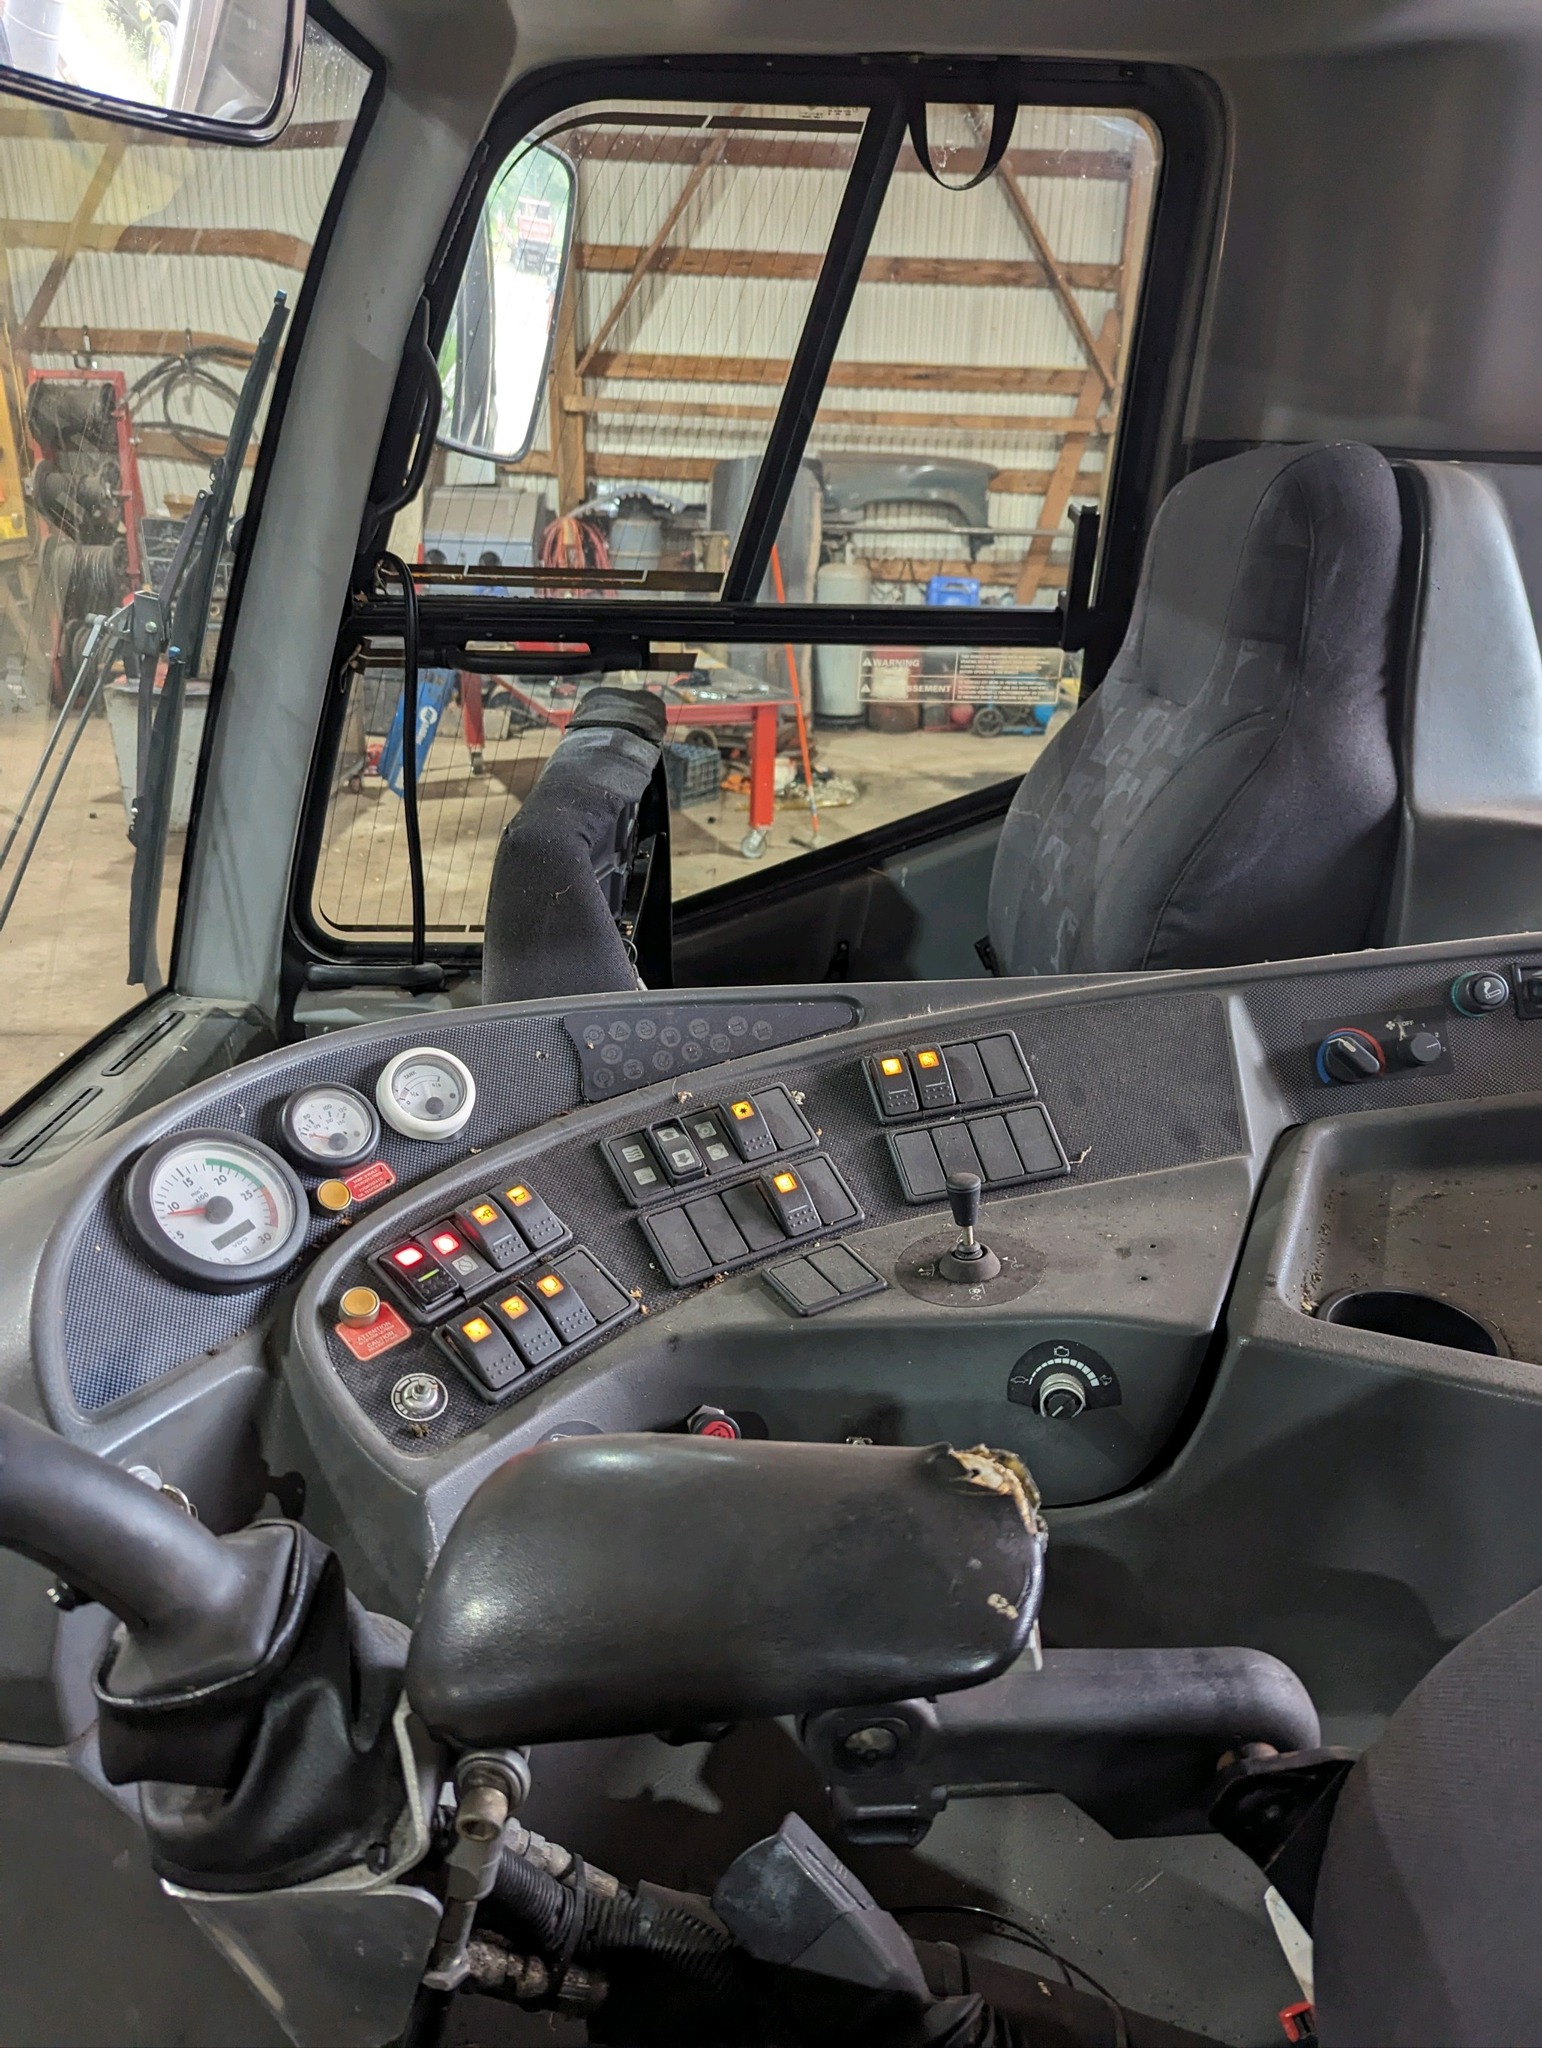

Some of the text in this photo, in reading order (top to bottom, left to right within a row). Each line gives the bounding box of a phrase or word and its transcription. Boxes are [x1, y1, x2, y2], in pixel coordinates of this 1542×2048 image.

[873, 659, 920, 667] WARNING
[323, 1103, 333, 1111] 100
[182, 1177, 194, 1188] 15
[213, 1174, 227, 1186] 20
[240, 1189, 253, 1201] 25
[168, 1201, 180, 1213] 10
[176, 1230, 185, 1240] 5
[257, 1232, 272, 1244] 30
[357, 1321, 392, 1343] ATTENTION
[366, 1331, 395, 1348] CAUTION
